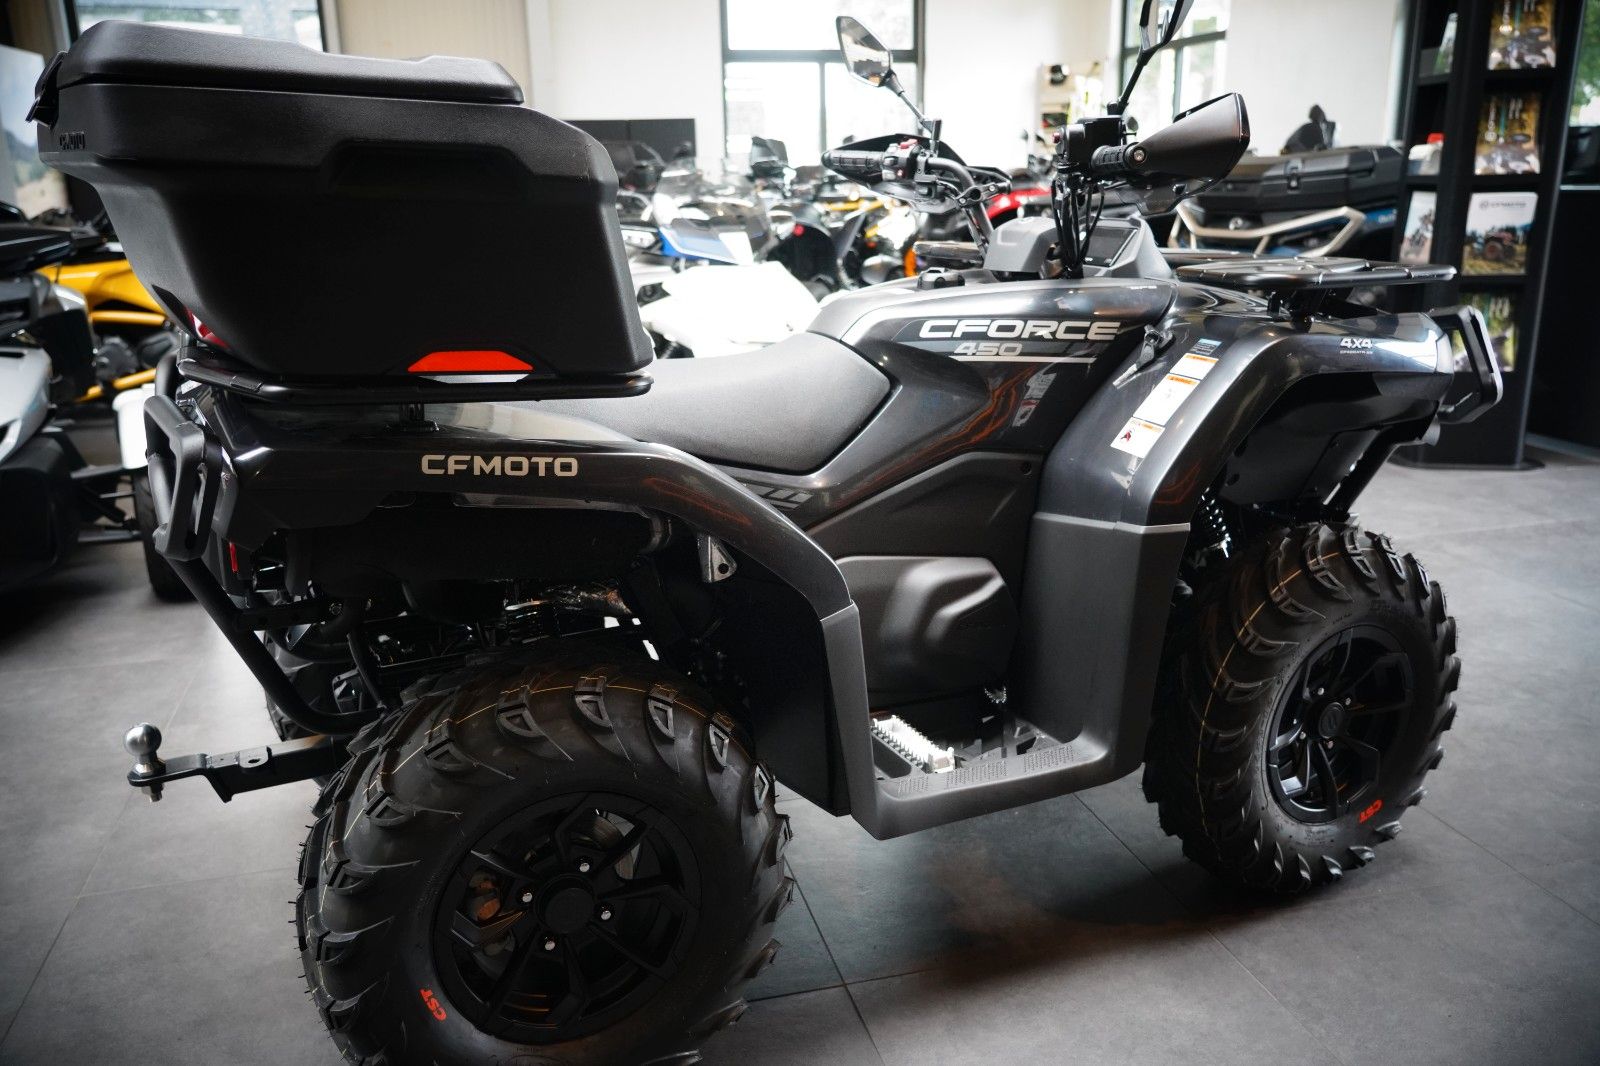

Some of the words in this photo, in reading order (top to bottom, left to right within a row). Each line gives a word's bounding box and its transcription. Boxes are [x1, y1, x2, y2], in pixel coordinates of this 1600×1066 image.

[919, 319, 1121, 341] CFORCE
[953, 342, 1023, 356] 450
[421, 454, 579, 477] CFMOTO
[419, 988, 447, 1021] CST
